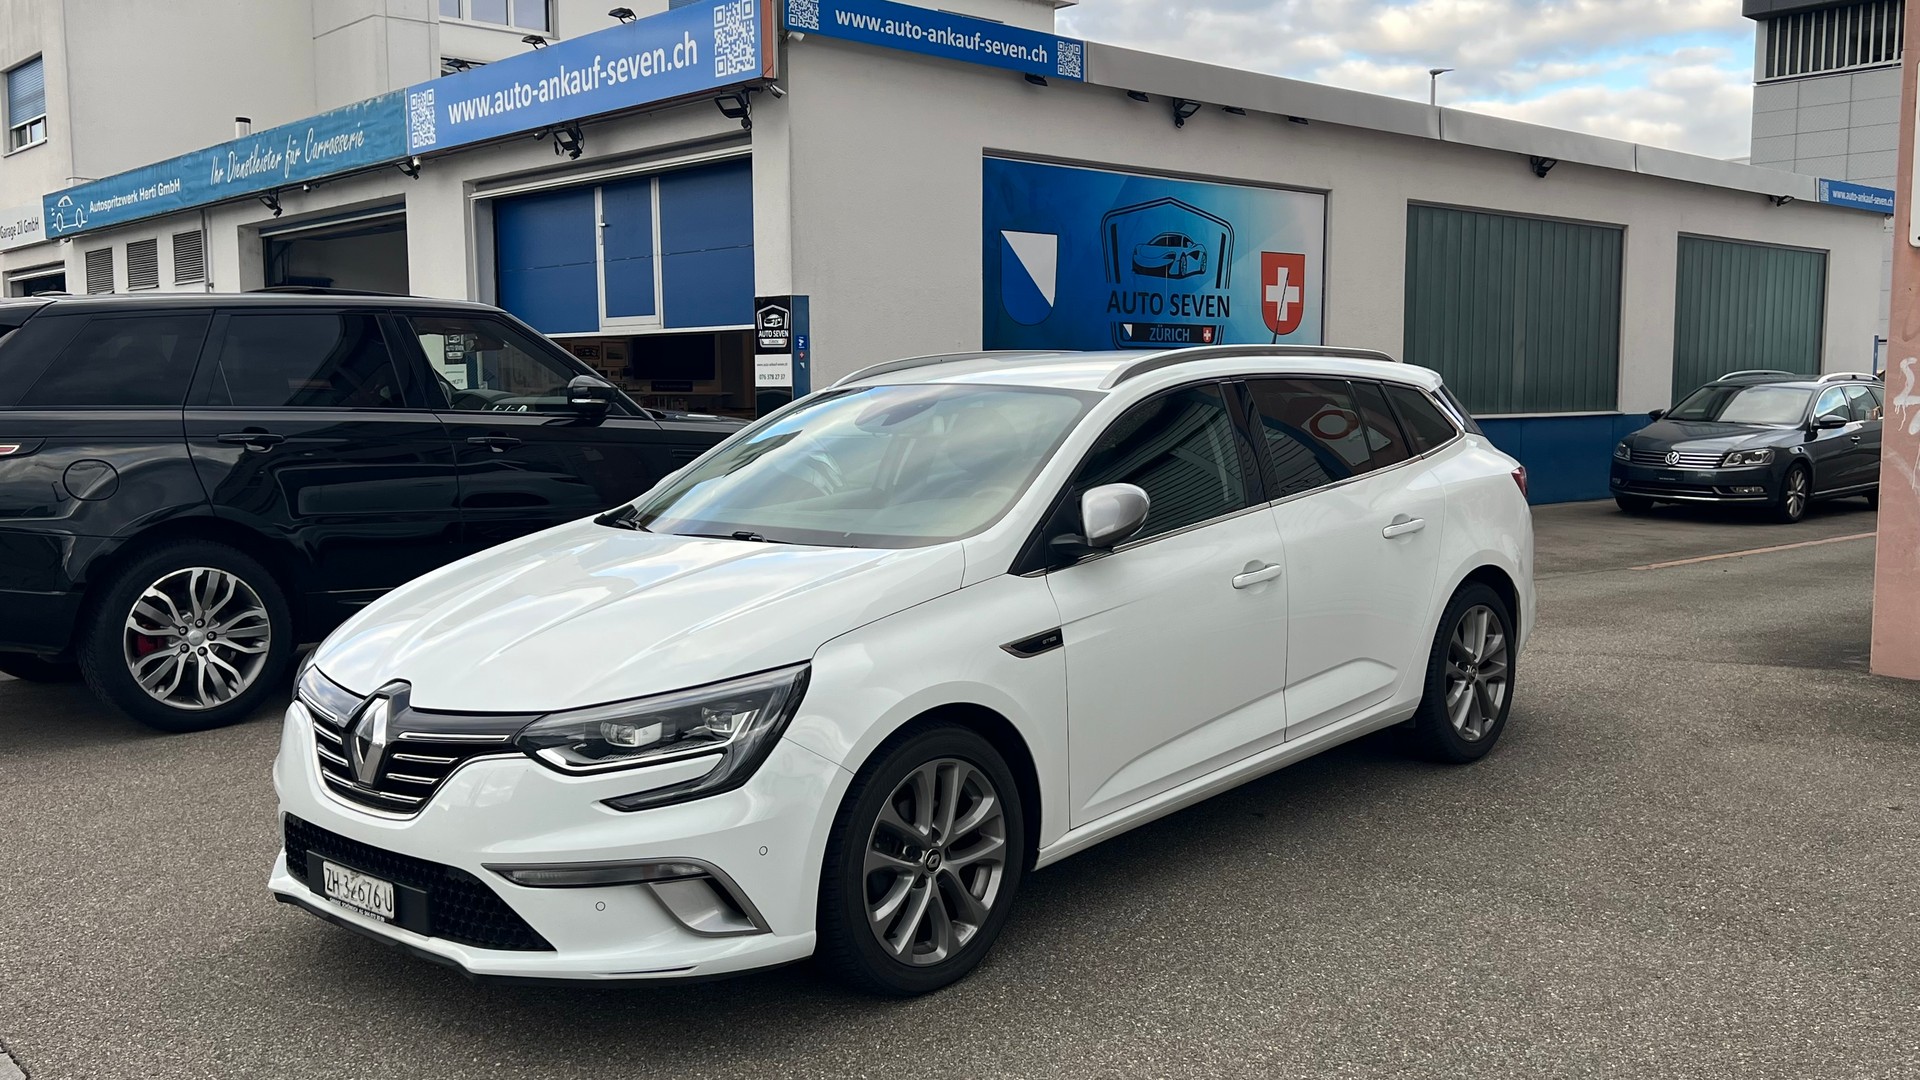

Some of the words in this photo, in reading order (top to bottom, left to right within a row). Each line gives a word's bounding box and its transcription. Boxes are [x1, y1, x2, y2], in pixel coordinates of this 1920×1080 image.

[835, 9, 1048, 64] www.auto-ankauf-seven.ch
[447, 30, 698, 125] www.auto-ankauf-seven.ch
[210, 155, 224, 186] Ihr
[226, 143, 282, 183] Dienstleister
[284, 134, 302, 179] für
[305, 121, 365, 164] Carrosserie
[89, 189, 139, 213] Autospritzwerk
[139, 186, 157, 202] Herti
[158, 178, 181, 197] GmbH
[24, 216, 40, 233] GmbH
[1106, 290, 1164, 315] AUTO
[1169, 293, 1230, 318] SEVEN
[758, 330, 773, 338] AUTO
[773, 330, 789, 338] SEVEN
[1149, 324, 1190, 342] ZÜRICH
